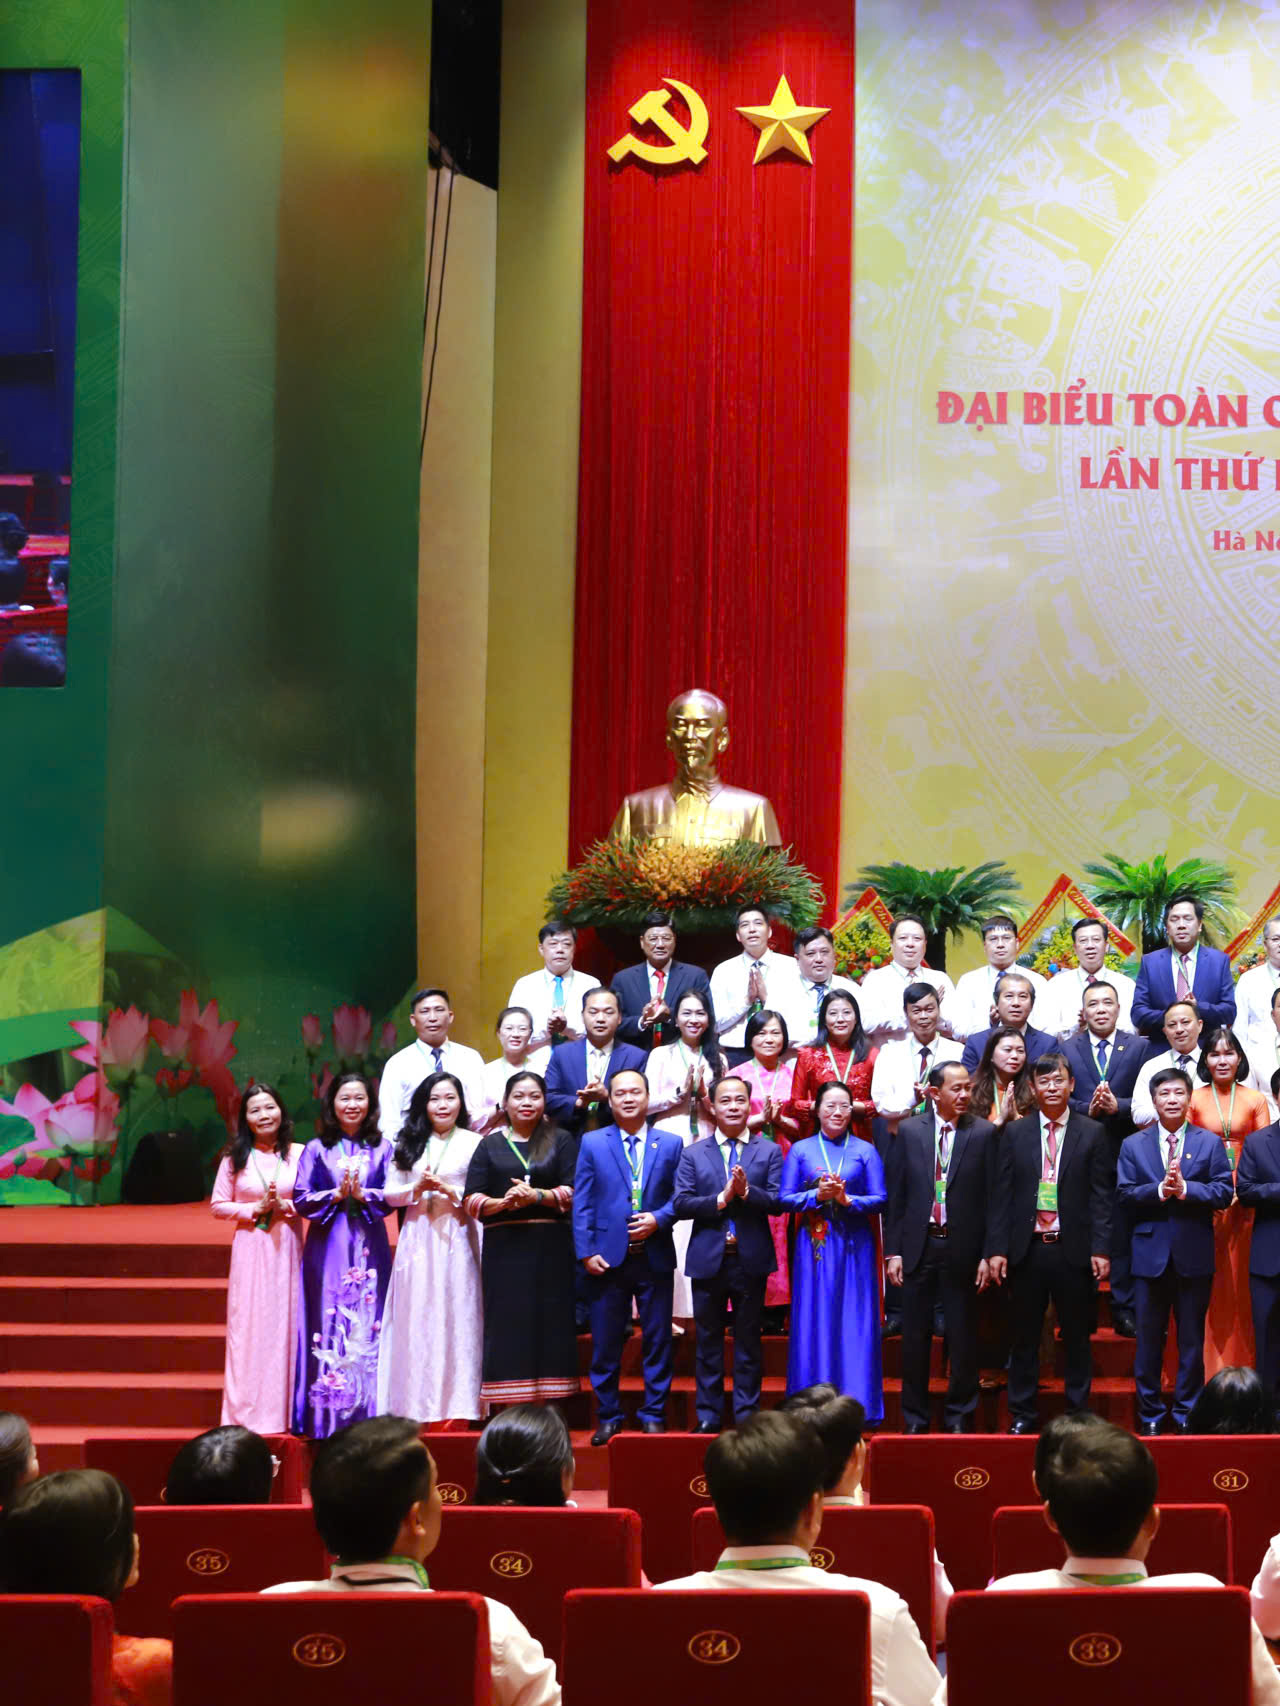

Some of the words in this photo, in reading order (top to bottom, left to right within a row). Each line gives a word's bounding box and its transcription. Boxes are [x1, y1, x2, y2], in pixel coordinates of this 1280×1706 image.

[936, 391, 1009, 432] ĐẠI
[1024, 377, 1114, 426] BIỂU
[1128, 384, 1249, 428] TOÀN
[1080, 445, 1161, 490] LẦN
[1174, 450, 1265, 492] THỨ
[1213, 529, 1247, 552] Hà
[961, 1473, 983, 1486] 32
[1220, 1475, 1238, 1487] 31
[441, 1489, 460, 1502] 34
[196, 1556, 222, 1570] 35
[499, 1556, 524, 1573] 34
[306, 1642, 335, 1661] 35
[699, 1639, 729, 1658] 34
[1080, 1642, 1110, 1660] 33
